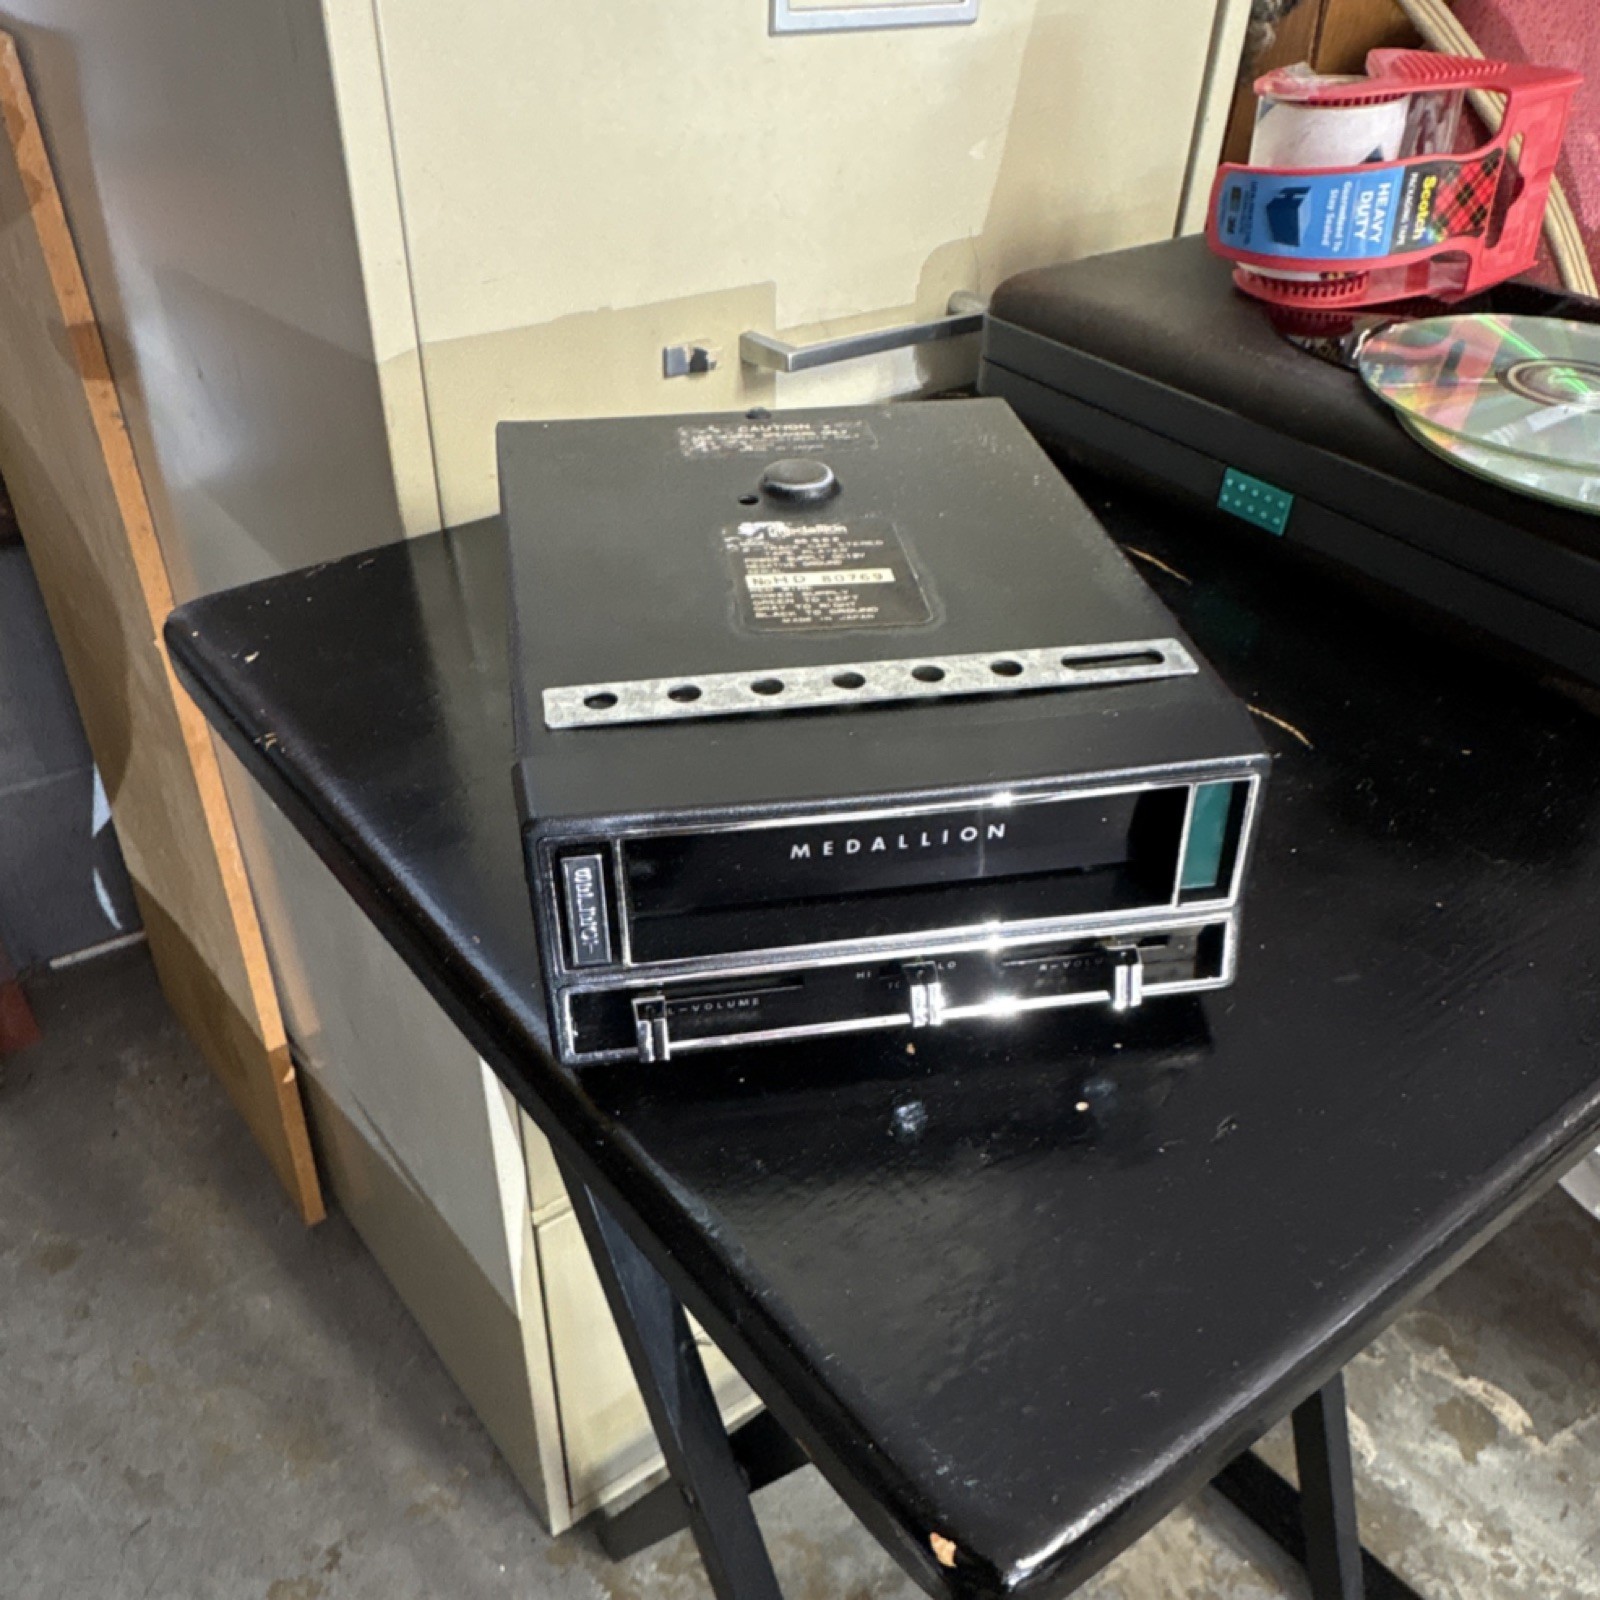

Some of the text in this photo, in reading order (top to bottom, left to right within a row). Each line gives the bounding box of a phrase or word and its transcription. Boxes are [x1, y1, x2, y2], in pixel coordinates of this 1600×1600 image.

[1353, 190, 1374, 239] DUTY
[1368, 182, 1392, 242] HEAVY
[1412, 174, 1437, 240] Scotch
[790, 822, 1007, 860] MEDALLION
[573, 867, 600, 955] SELECT
